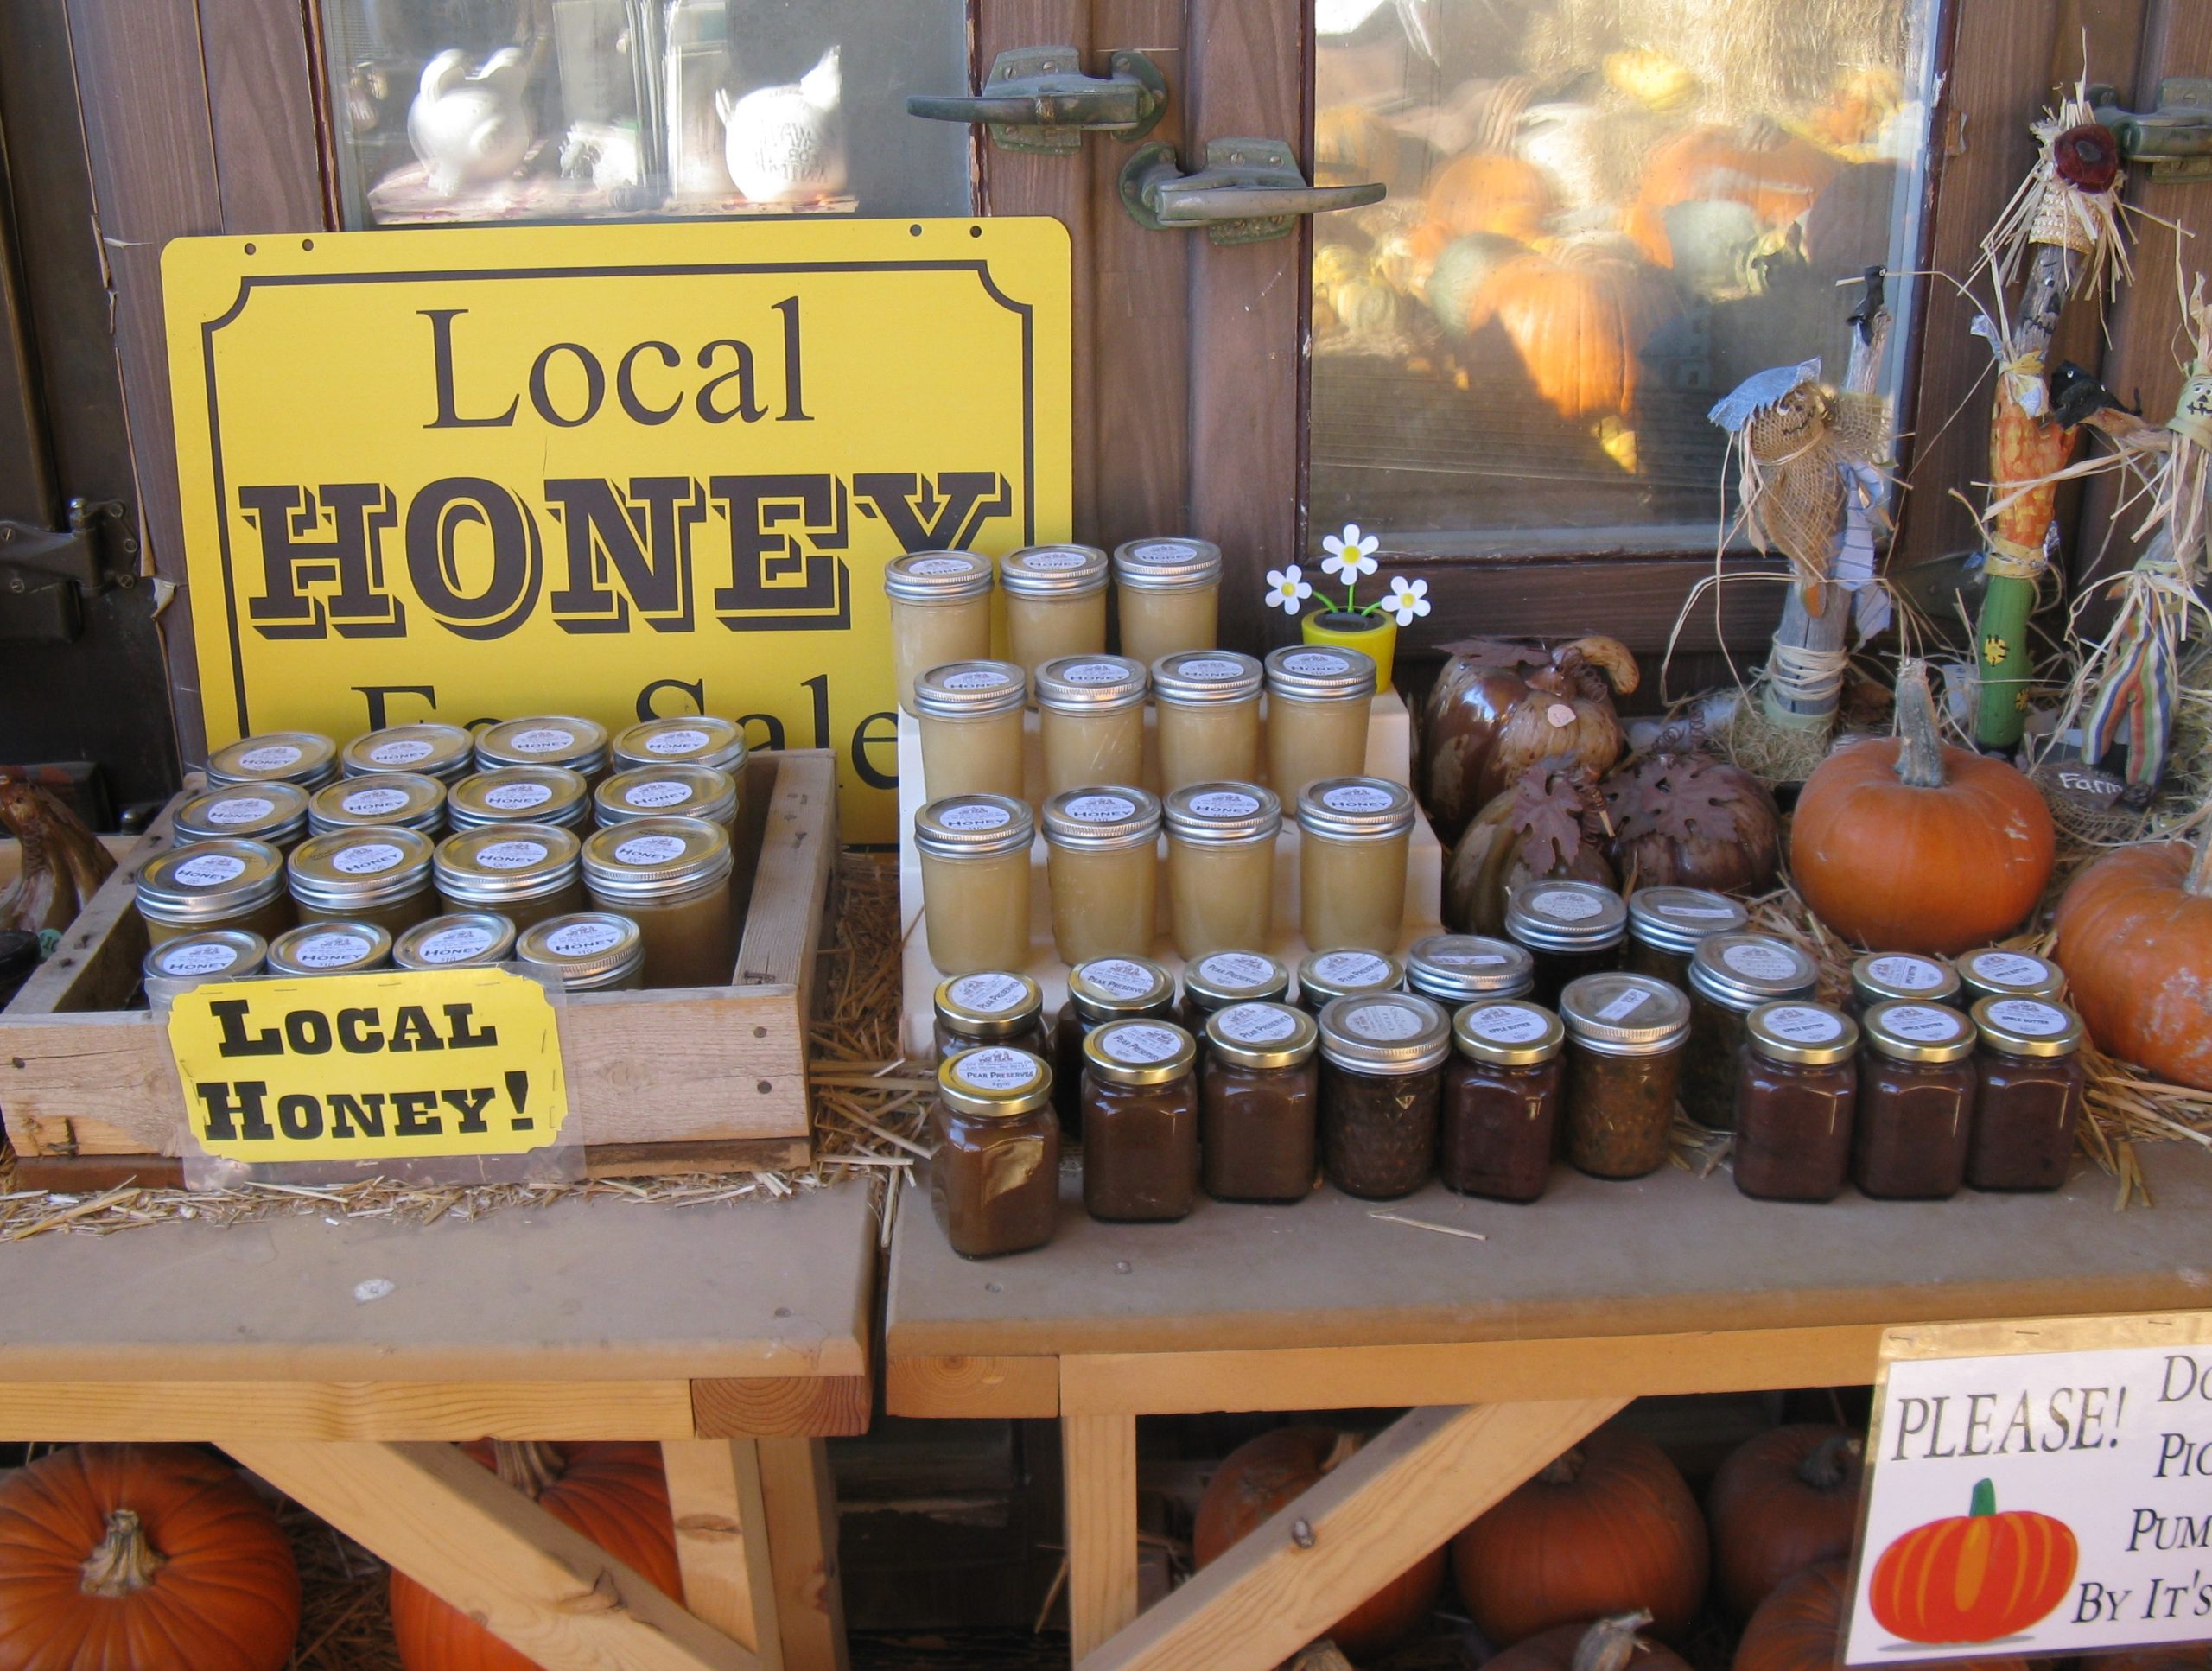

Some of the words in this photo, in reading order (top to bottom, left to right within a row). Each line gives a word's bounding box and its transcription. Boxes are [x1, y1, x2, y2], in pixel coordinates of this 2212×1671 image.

[416, 295, 815, 429] Local
[238, 471, 1012, 639] HONEY
[518, 740, 569, 749] HONEY
[649, 740, 702, 750] HONEY
[242, 757, 291, 766] HONEY
[375, 751, 428, 760] HONEY
[2058, 772, 2125, 796] Farm
[487, 796, 542, 805] HONEY
[632, 791, 687, 804] HONEY
[349, 800, 404, 811] HONEY
[479, 854, 535, 863] HONEY
[619, 848, 671, 861] HONEY
[346, 853, 397, 872] HONEY
[176, 868, 229, 881] HONEY
[424, 946, 484, 956] HONEY
[556, 937, 616, 952] HONEY
[302, 953, 362, 962] HONEY
[169, 961, 228, 969] HONEY
[209, 999, 498, 1058] LOCAL
[196, 1071, 534, 1141] HONEY!
[1891, 1386, 2126, 1461] PLEASE!
[2125, 1509, 2212, 1552] PUM
[2070, 1581, 2133, 1623] BY
[2140, 1569, 2212, 1619] IT'S
